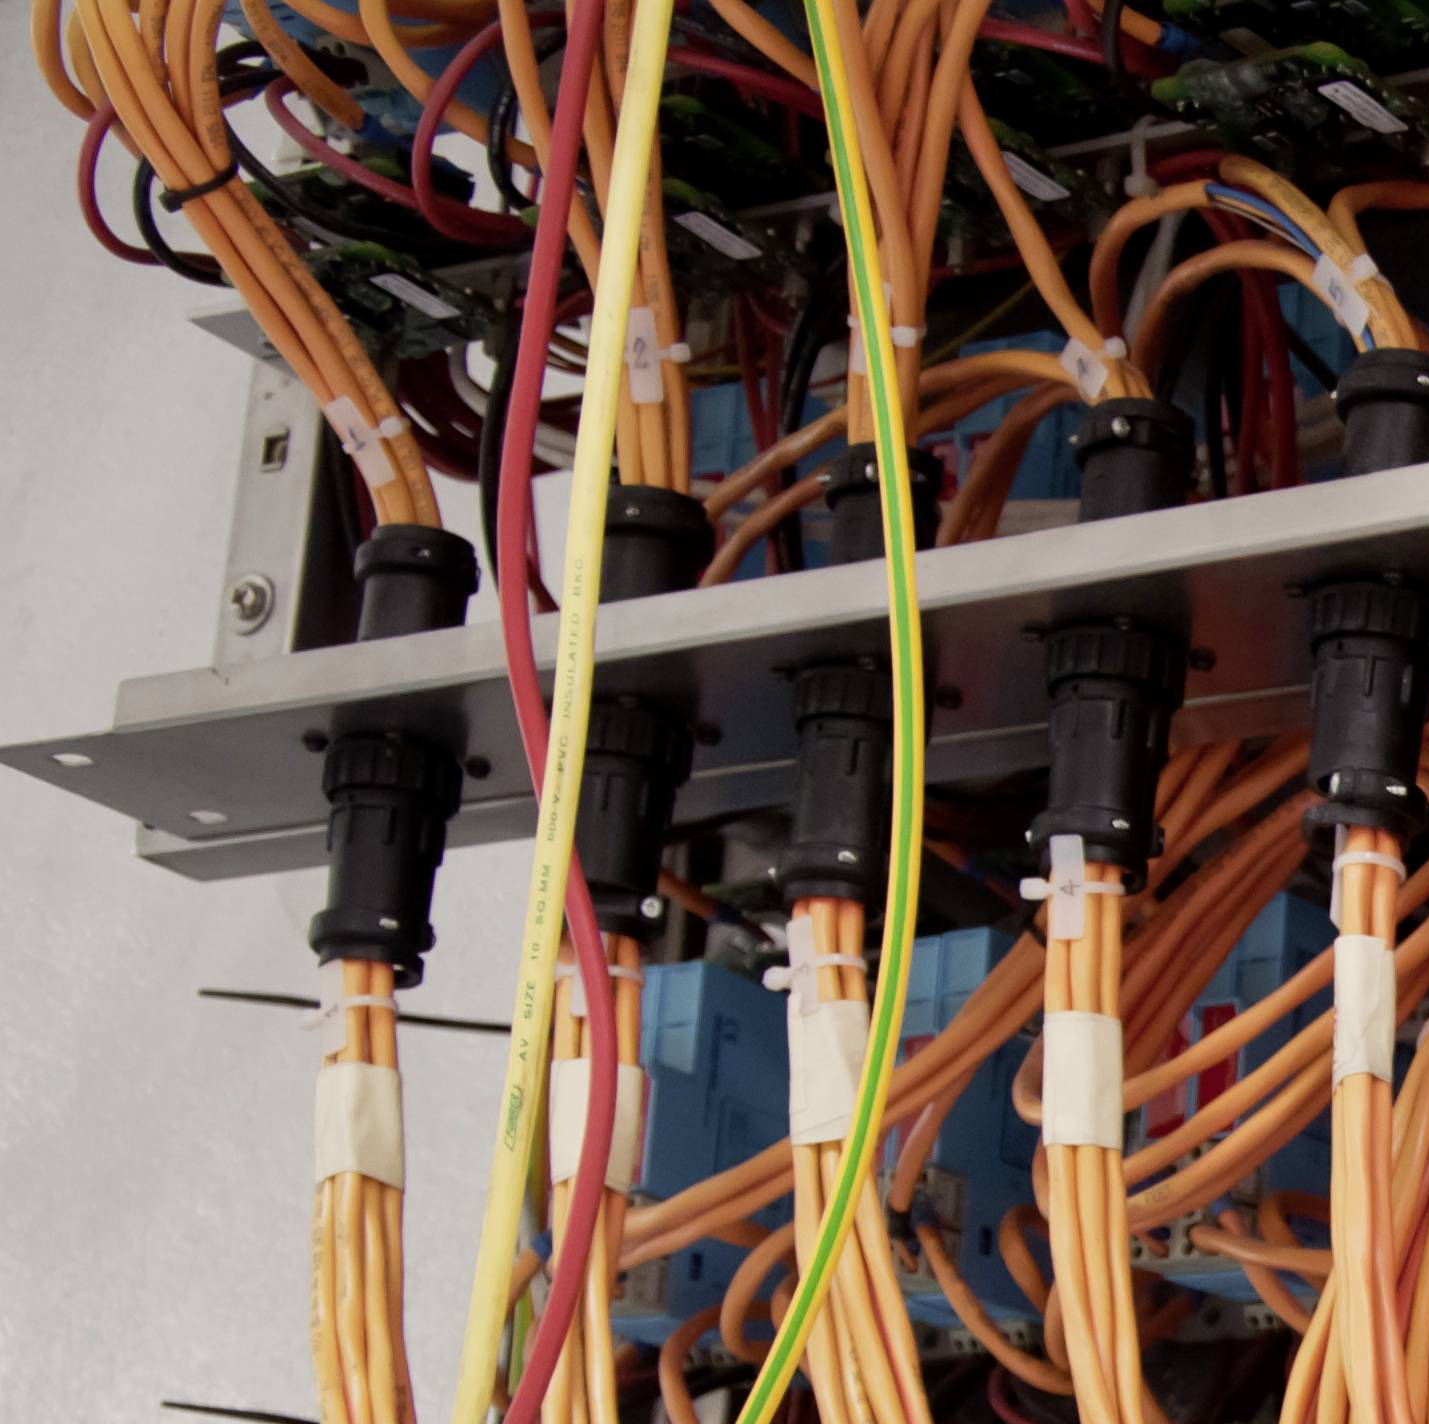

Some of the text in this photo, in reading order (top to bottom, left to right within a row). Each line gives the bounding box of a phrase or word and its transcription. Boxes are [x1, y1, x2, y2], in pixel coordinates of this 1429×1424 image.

[632, 337, 649, 370] 2
[348, 425, 367, 452] 1
[562, 613, 581, 720] INSULATED
[522, 979, 536, 1021] SIZE
[518, 1037, 529, 1062] AV
